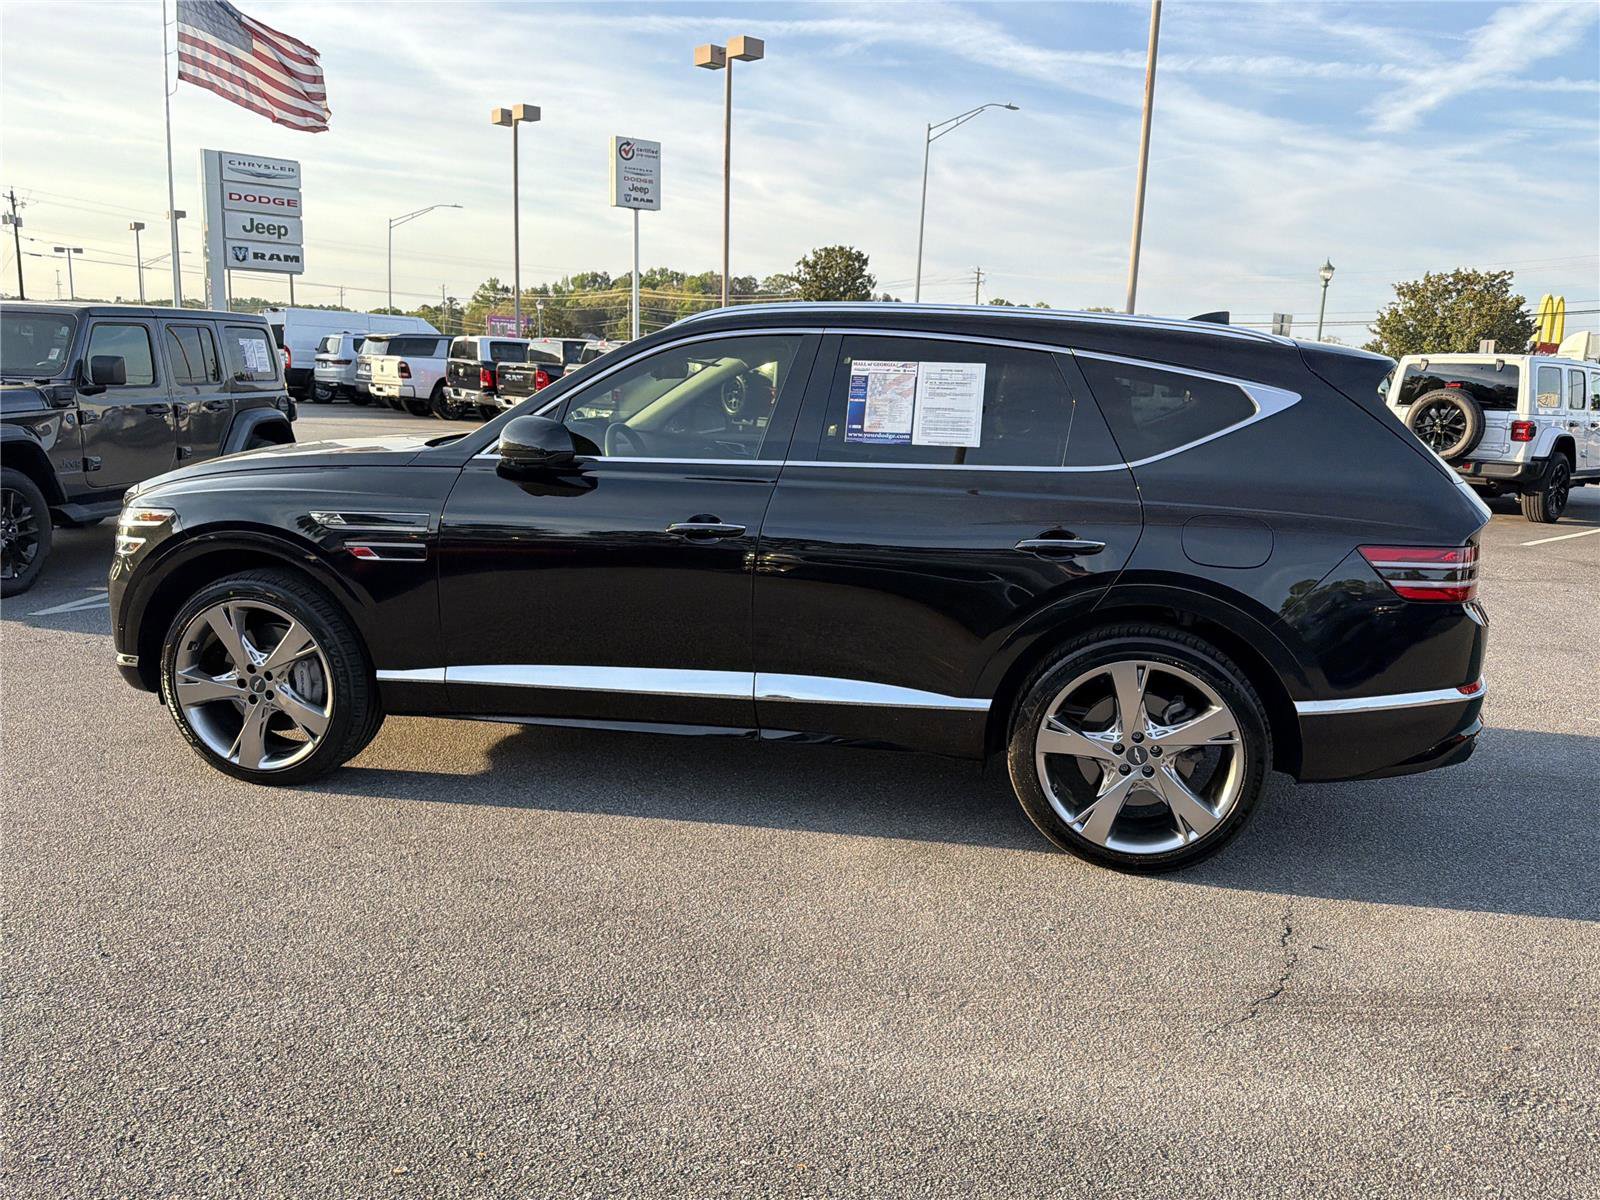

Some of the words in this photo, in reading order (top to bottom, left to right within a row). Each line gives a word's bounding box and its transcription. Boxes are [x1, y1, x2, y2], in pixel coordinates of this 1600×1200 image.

[228, 160, 295, 172] CHRYSLER
[628, 183, 649, 195] Jeep
[228, 192, 298, 208] DODGE
[242, 217, 289, 239] Jeep
[252, 251, 300, 263] RAM
